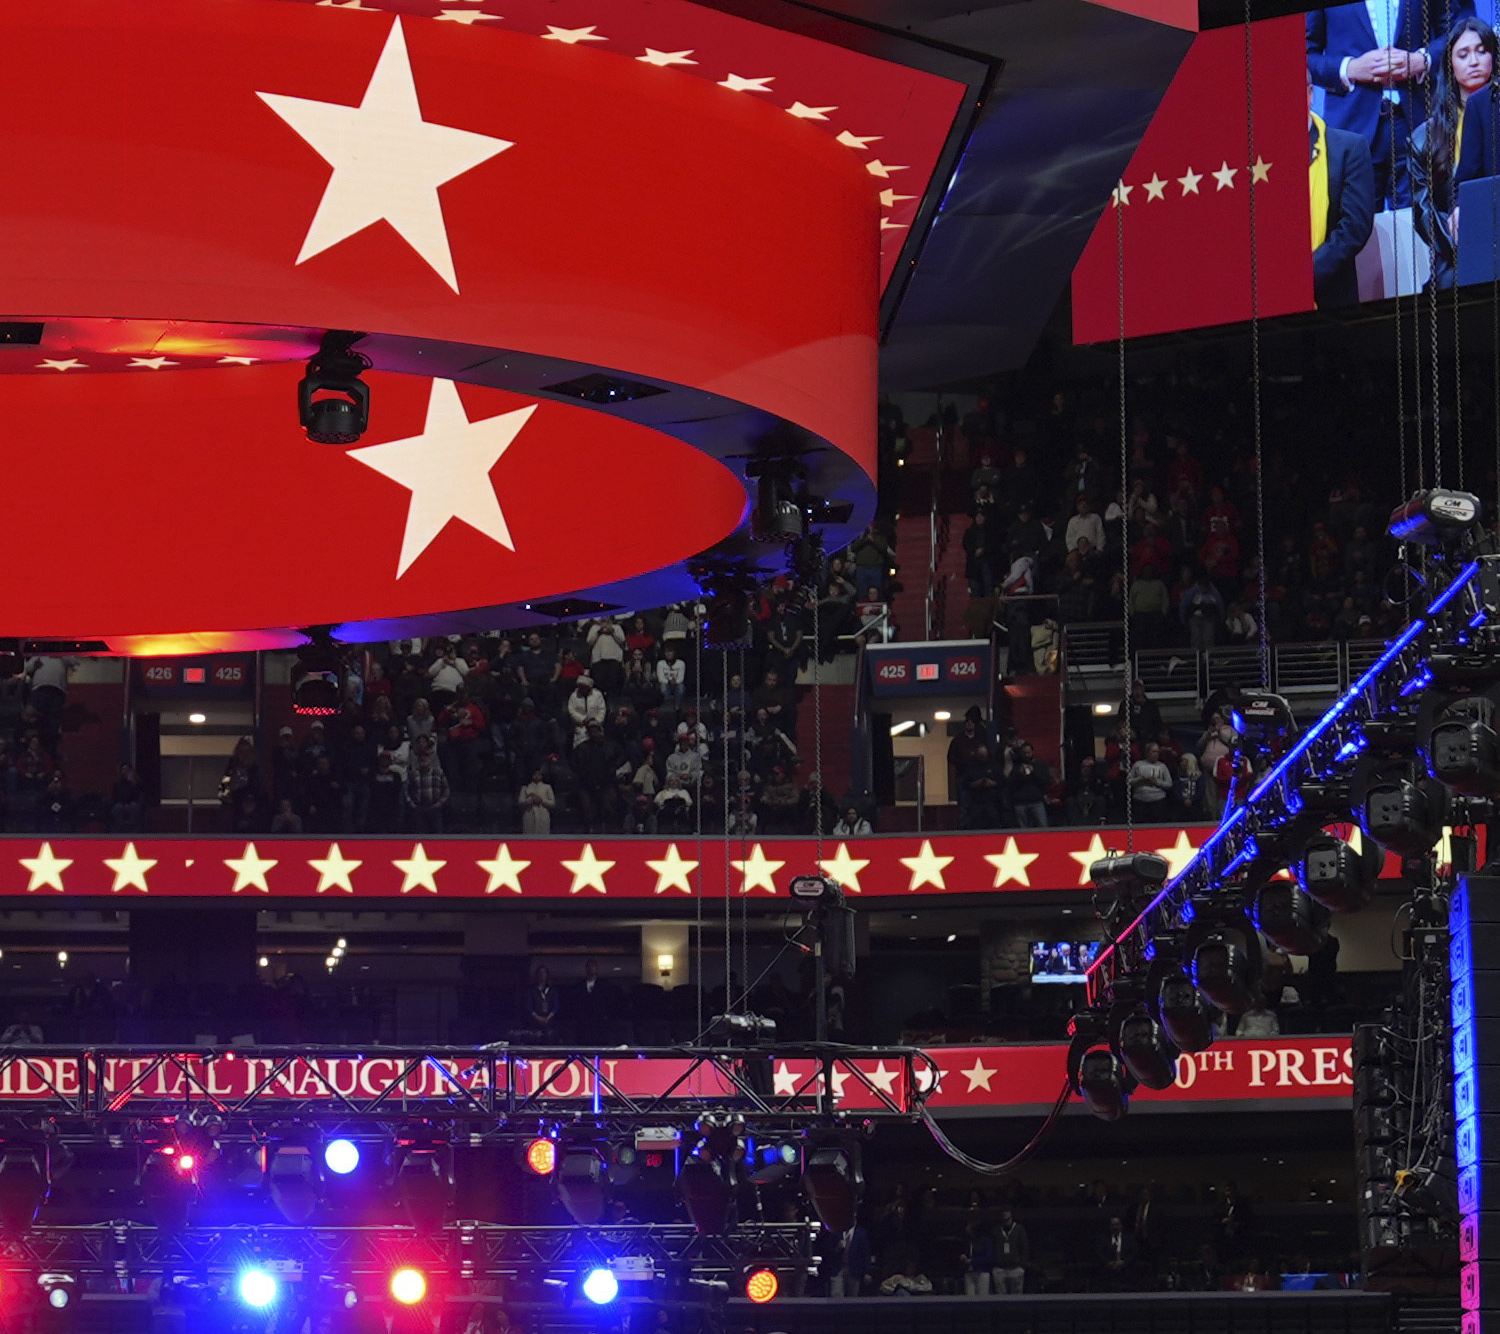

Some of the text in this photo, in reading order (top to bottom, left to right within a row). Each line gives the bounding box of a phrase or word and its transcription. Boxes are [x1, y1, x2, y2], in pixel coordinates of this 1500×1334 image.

[146, 666, 172, 681] 426
[215, 666, 241, 681] 425
[880, 665, 906, 679] 425
[950, 661, 977, 676] 424
[1174, 1051, 1234, 1089] 0TH
